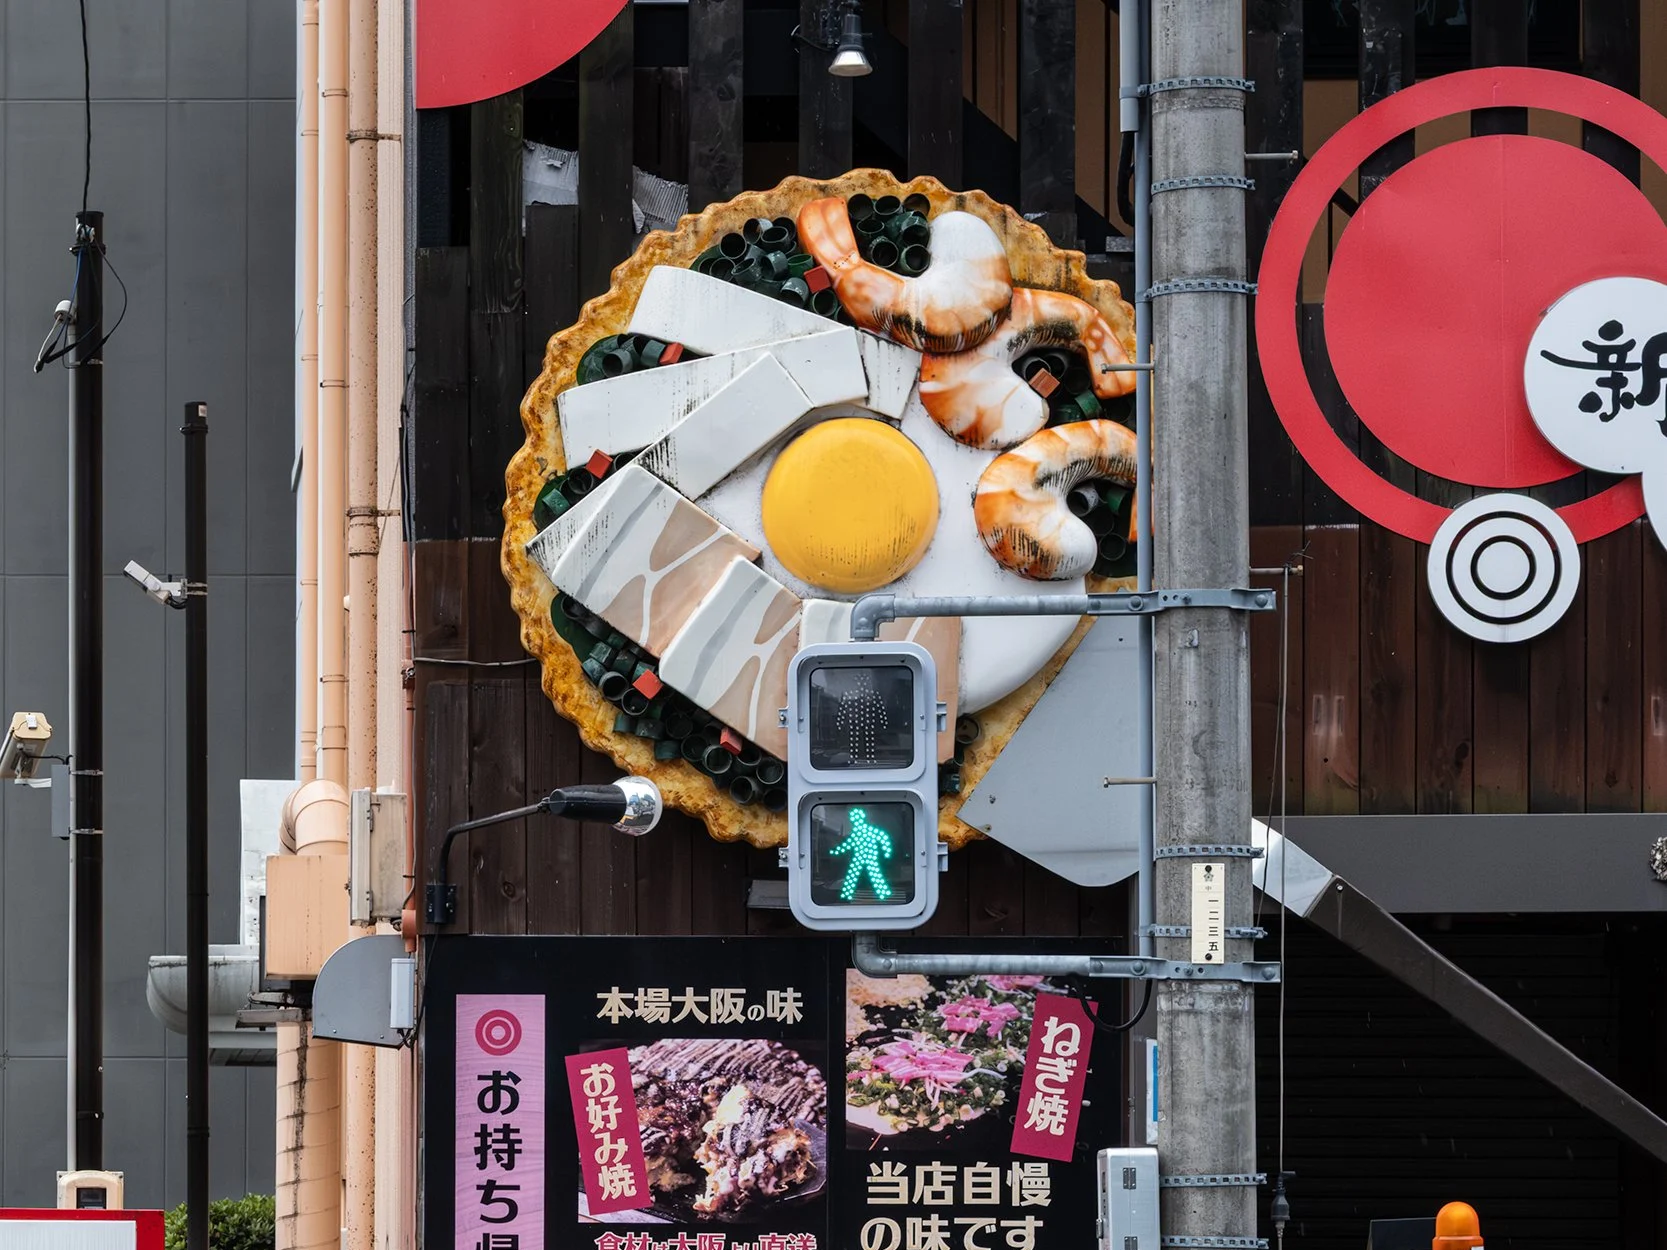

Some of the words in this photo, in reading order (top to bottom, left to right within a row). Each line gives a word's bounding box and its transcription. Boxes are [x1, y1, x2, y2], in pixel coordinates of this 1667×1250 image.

[1208, 900, 1219, 951] 一二三五
[596, 986, 803, 1025] 本場大阪の味
[1024, 1016, 1081, 1136] ねぎ焼
[580, 1061, 637, 1201] お好み焼
[867, 1161, 1052, 1207] 当店自慢
